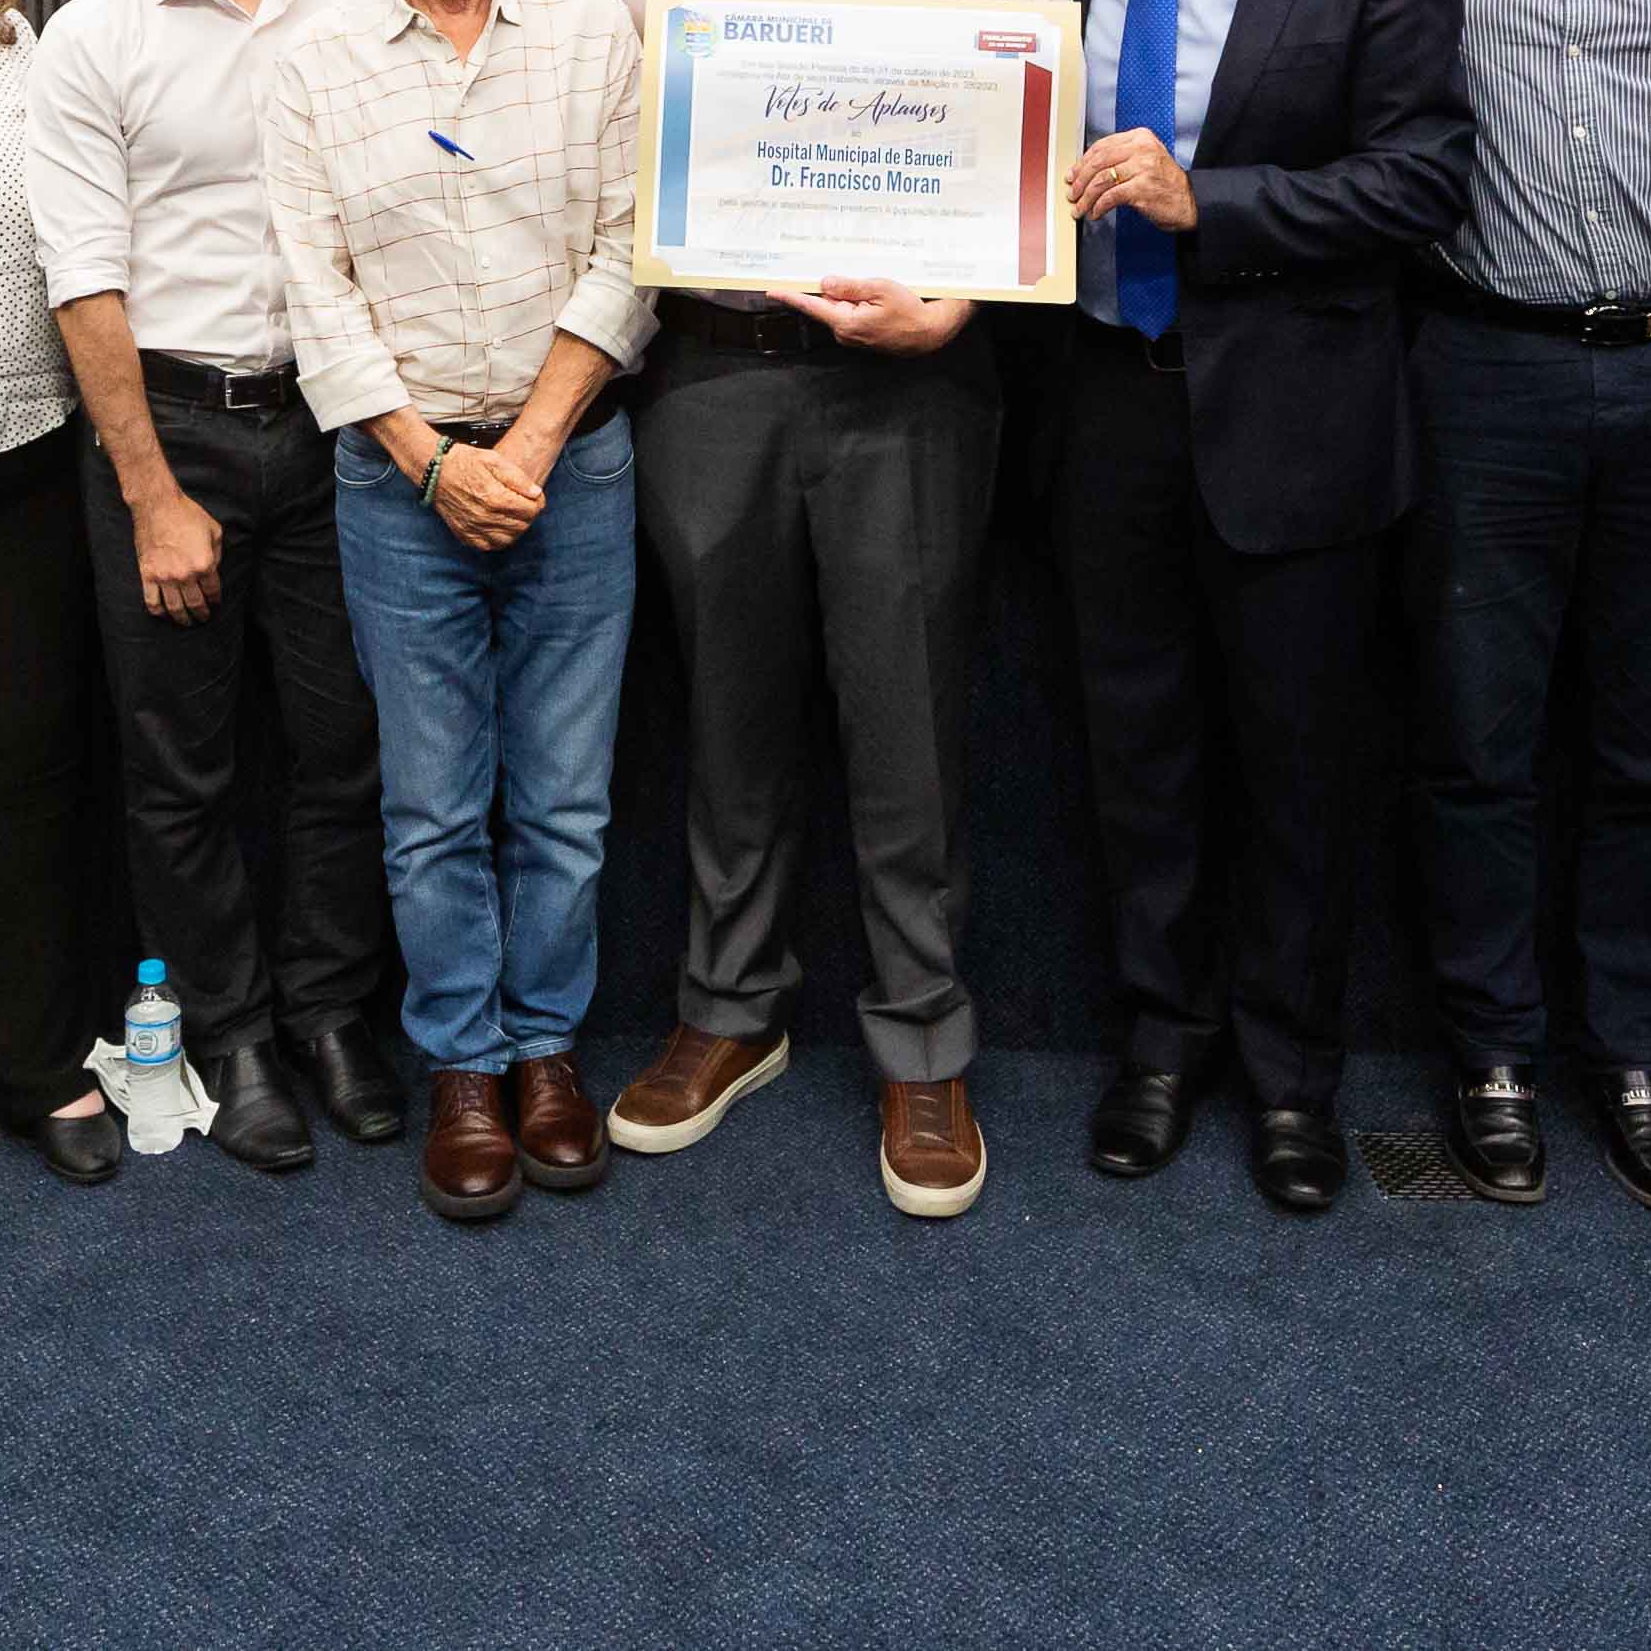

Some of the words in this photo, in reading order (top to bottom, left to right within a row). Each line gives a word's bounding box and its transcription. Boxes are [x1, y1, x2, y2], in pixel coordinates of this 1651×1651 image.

[724, 21, 833, 44] BARUERI
[764, 83, 811, 122] Votos
[817, 89, 840, 112] de
[847, 90, 950, 125] Aplausos
[757, 140, 812, 163] Hospital
[816, 143, 881, 165] Municipal
[885, 148, 901, 164] de
[904, 148, 953, 167] Barueri
[771, 164, 794, 187] Dr.
[800, 166, 881, 191] Francisco
[886, 170, 941, 194] Moran
